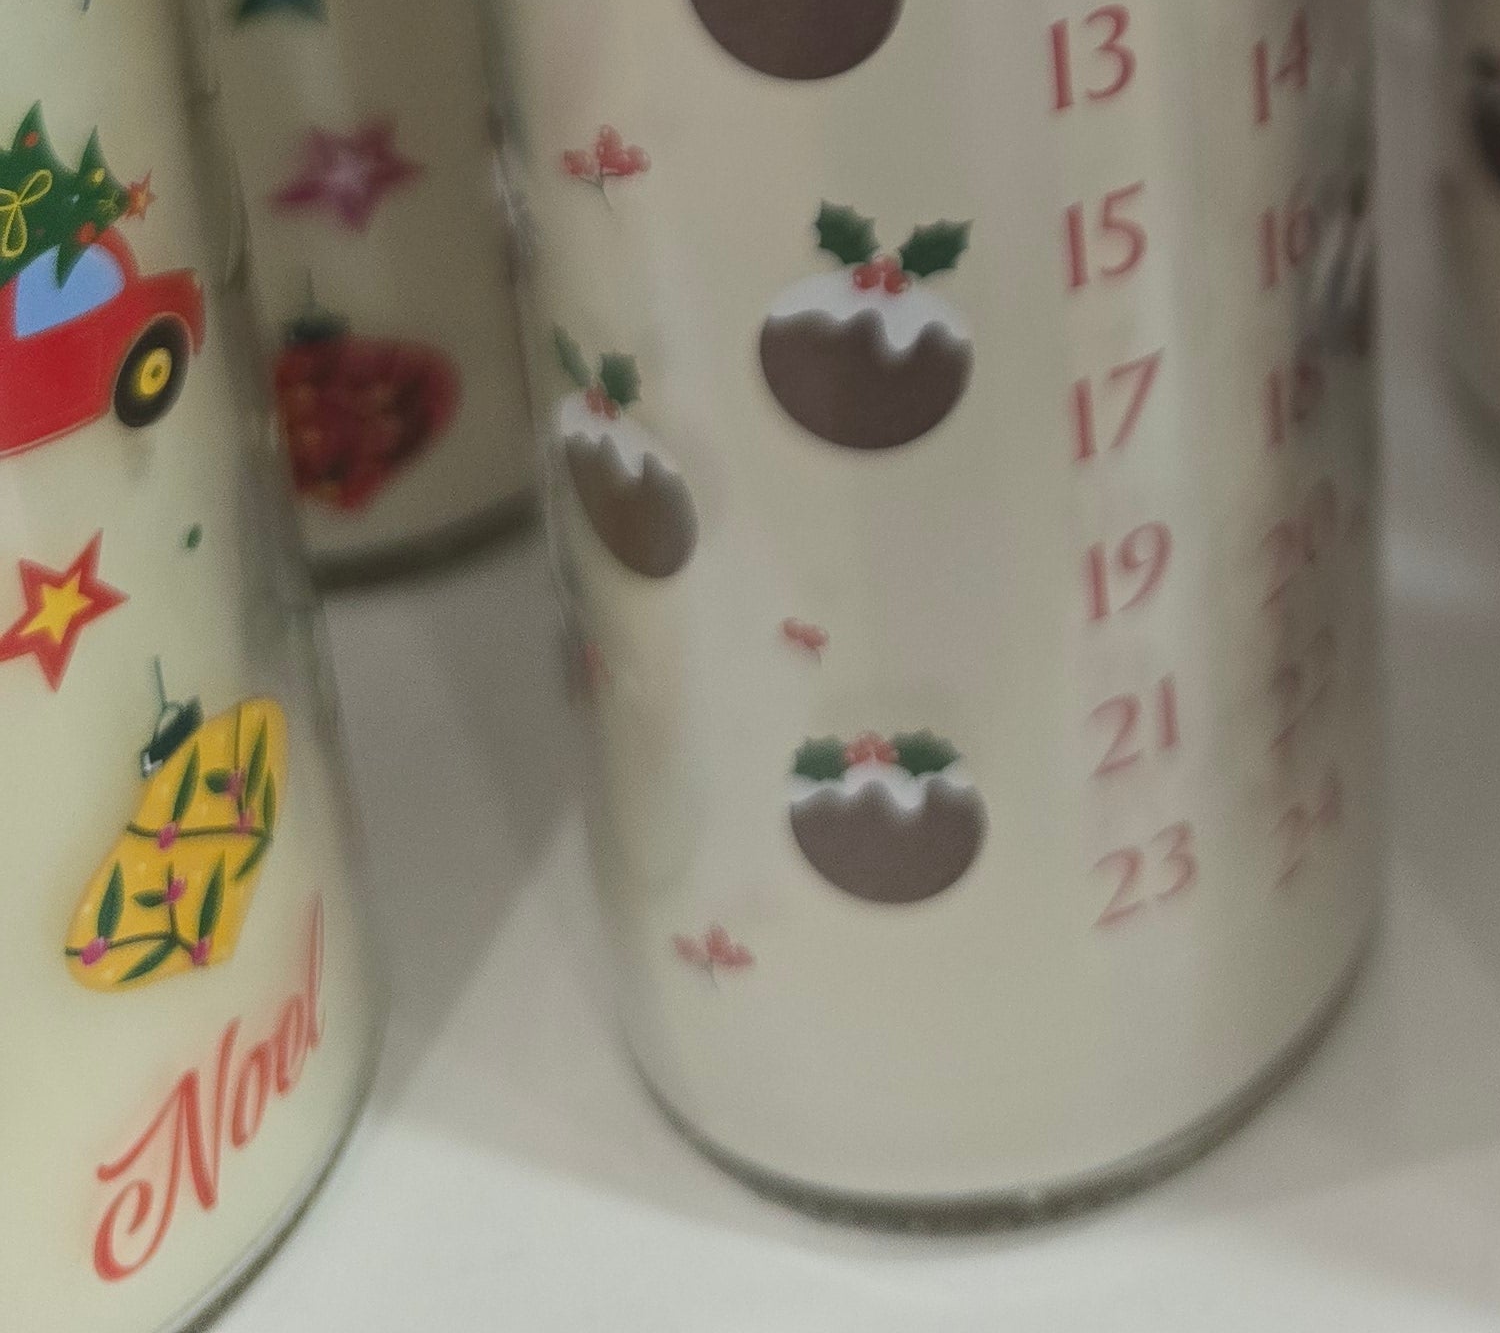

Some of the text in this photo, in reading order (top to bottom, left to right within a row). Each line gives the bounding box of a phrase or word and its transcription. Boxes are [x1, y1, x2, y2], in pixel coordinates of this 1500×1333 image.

[1048, 4, 1136, 111] 13
[1250, 15, 1310, 125] 14
[1061, 182, 1147, 291] 15
[1069, 349, 1164, 463] 17
[1083, 521, 1172, 622] 19
[1090, 673, 1178, 778] 21
[1092, 819, 1199, 930] 23
[92, 890, 326, 1285] Noel
